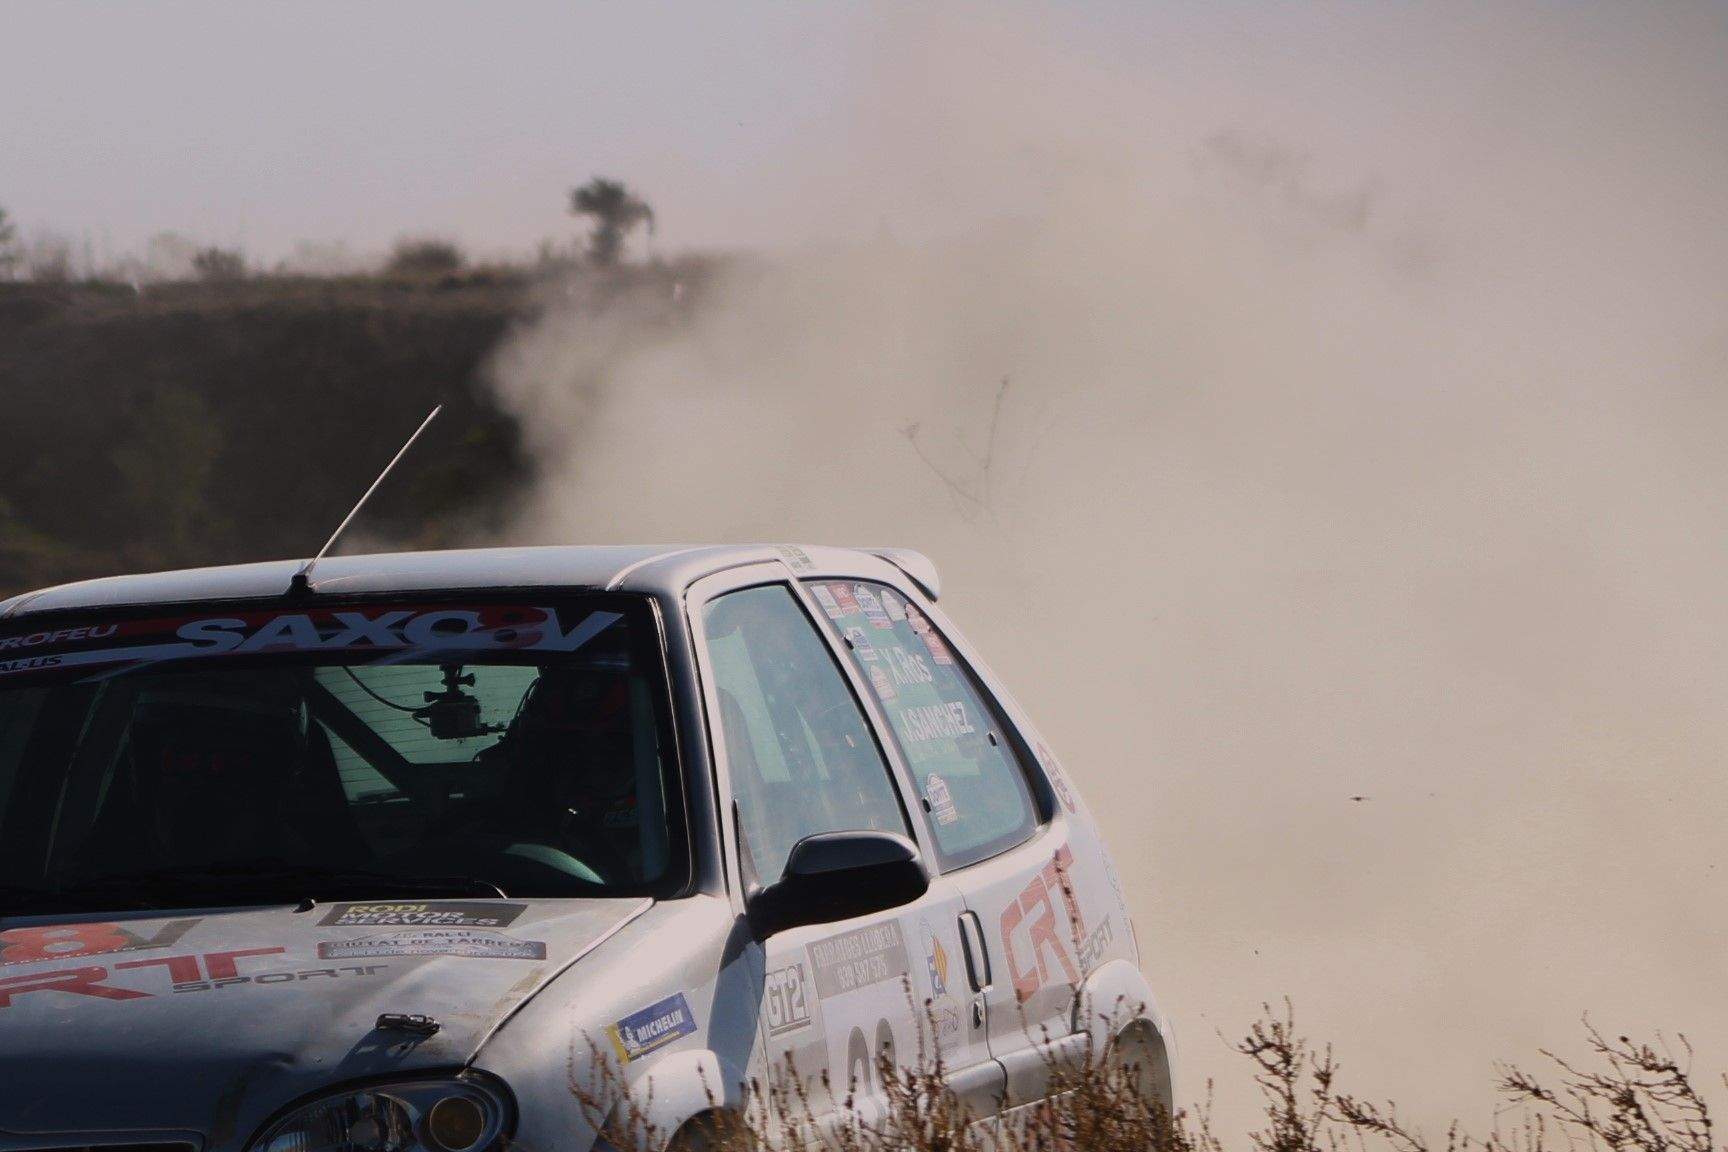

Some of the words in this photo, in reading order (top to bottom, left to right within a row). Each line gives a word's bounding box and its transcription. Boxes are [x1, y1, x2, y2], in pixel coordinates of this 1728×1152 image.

[346, 902, 429, 914] RODI
[333, 916, 499, 926] SERVICES
[339, 910, 465, 920] MOTOR
[172, 964, 389, 994] SPORT
[637, 1009, 685, 1043] MICHELIN
